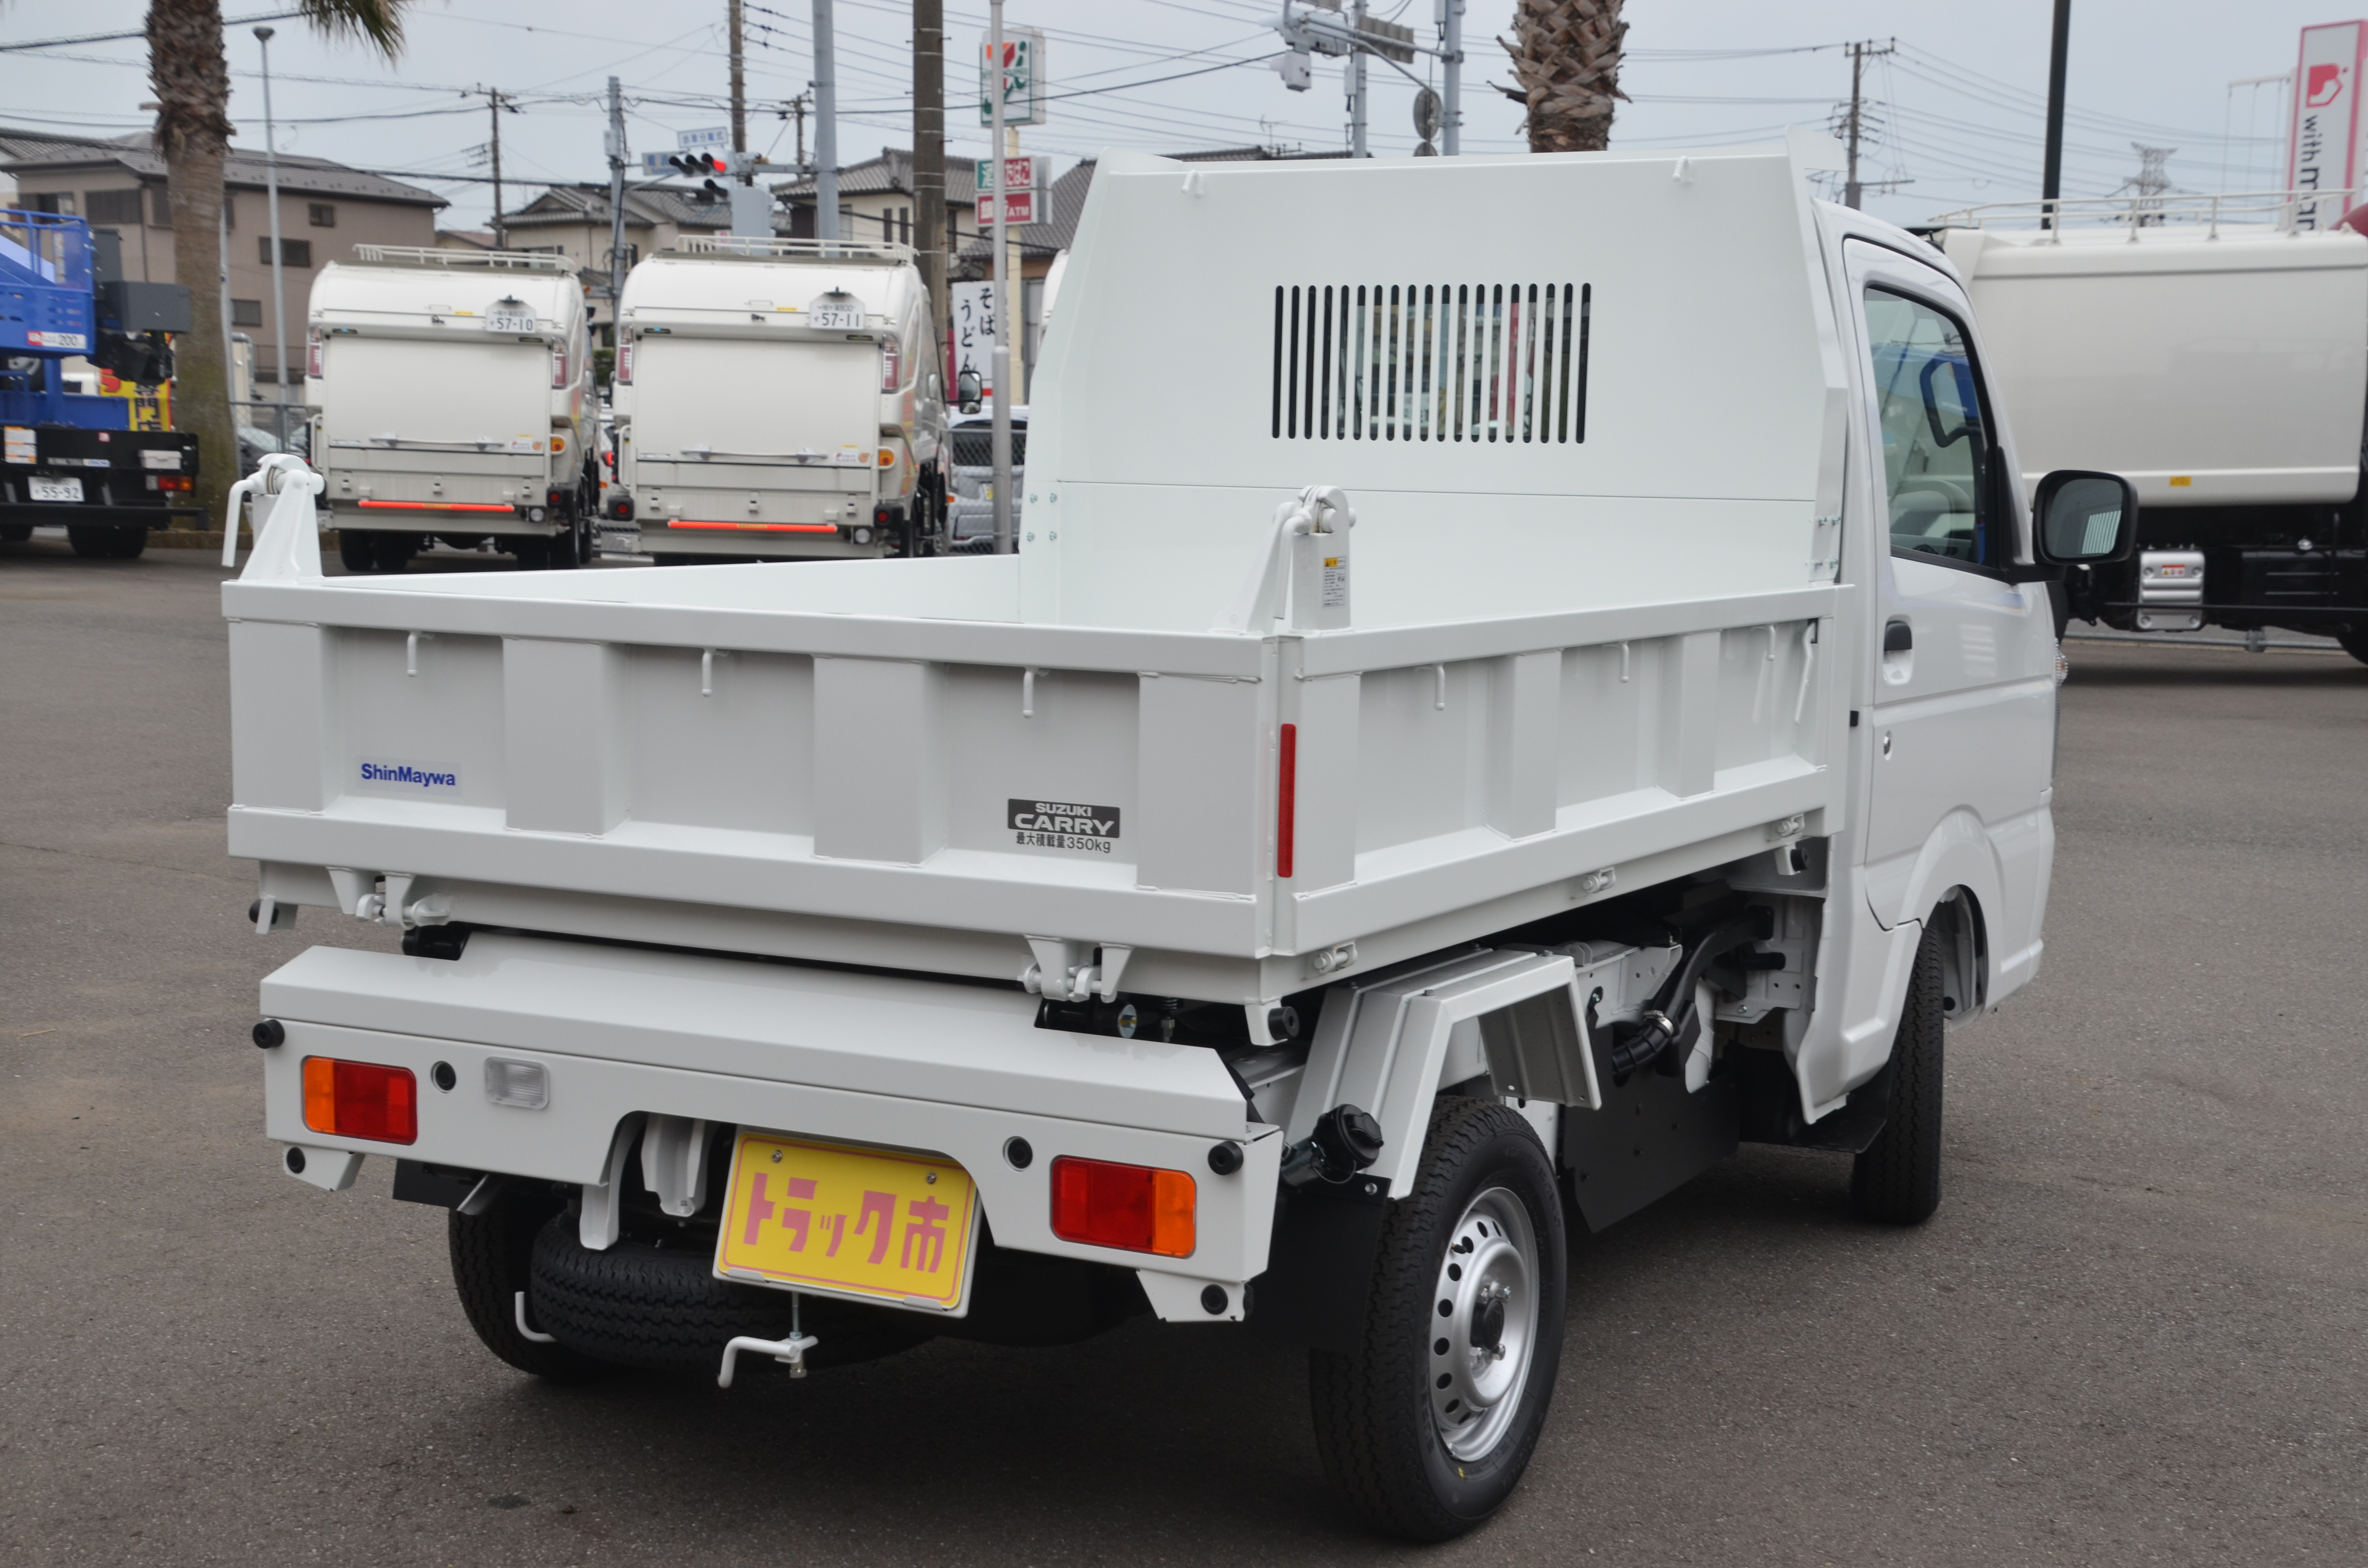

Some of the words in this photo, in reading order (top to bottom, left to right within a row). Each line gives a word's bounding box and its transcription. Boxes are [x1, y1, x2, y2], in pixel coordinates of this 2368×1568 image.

[2300, 115, 2323, 162] with
[497, 317, 533, 331] 57-10
[822, 312, 859, 327] 57-11
[41, 485, 80, 499] 55-92
[361, 763, 456, 787] ShinMaywa
[1035, 802, 1092, 817] SUZUKI
[1014, 813, 1115, 835] CARRY
[1016, 831, 1111, 854] 最大積載量350kg
[743, 1172, 950, 1274] トラック市
